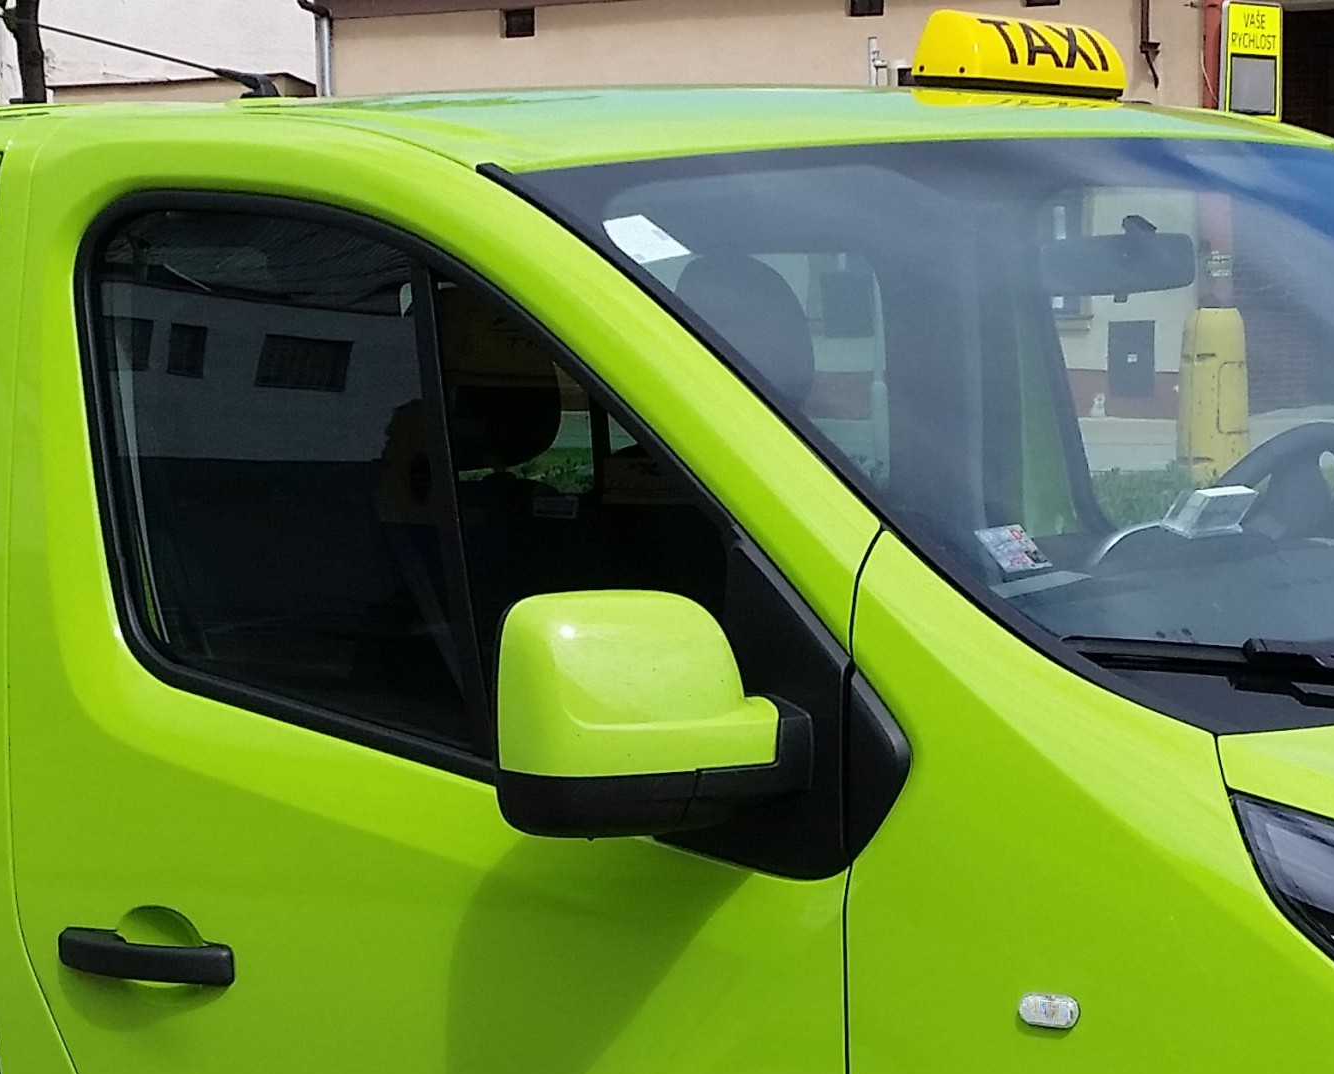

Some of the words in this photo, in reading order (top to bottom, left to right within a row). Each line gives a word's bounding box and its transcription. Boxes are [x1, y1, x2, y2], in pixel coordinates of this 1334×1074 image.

[1244, 10, 1266, 30] VAŠE
[977, 18, 1109, 72] TAXI
[1231, 32, 1276, 52] RYCHLOST
